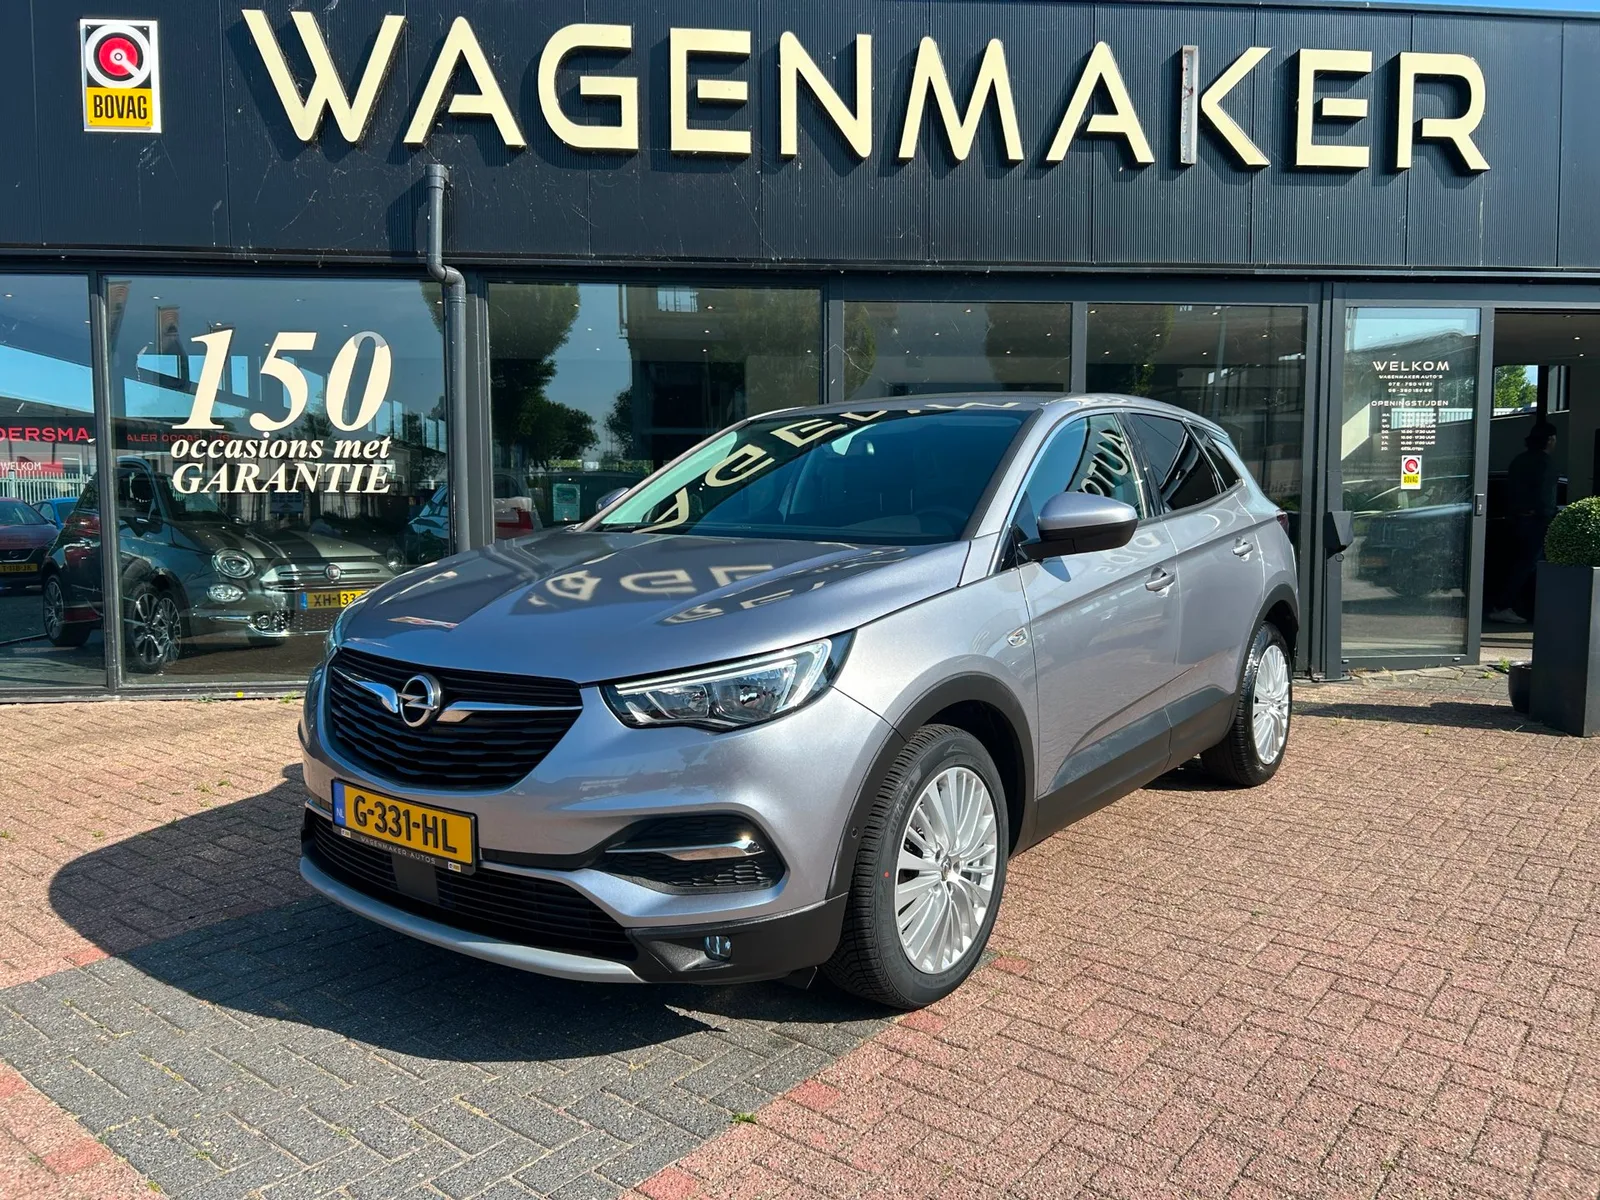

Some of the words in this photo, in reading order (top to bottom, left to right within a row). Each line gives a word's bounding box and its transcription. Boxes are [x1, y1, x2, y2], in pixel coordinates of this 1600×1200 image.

[242, 9, 1491, 171] WAGENMAKER
[93, 94, 148, 120] BOVAG
[1372, 360, 1450, 372] WELKOM
[171, 329, 392, 432] 150
[170, 431, 324, 459] occasions
[333, 435, 393, 459] met
[0, 461, 42, 471] WELKOM
[171, 462, 394, 494] GARANTIE
[353, 795, 457, 854] G-331-HL
[410, 851, 436, 865] AUTOS
